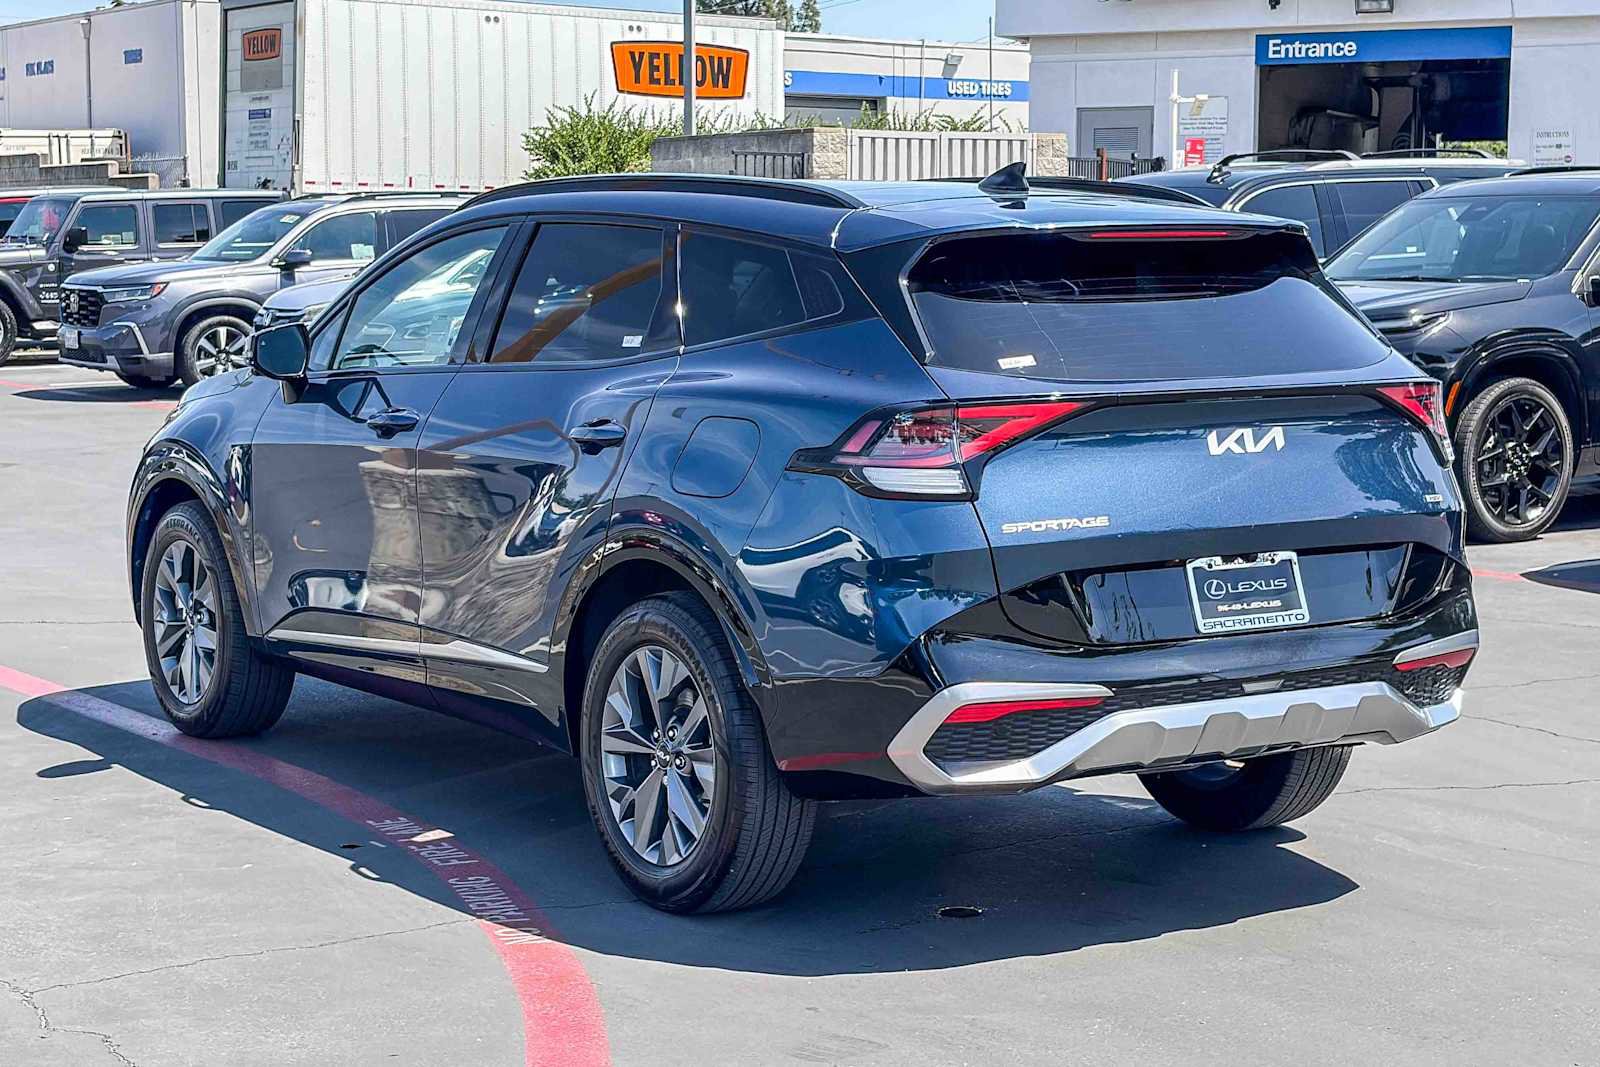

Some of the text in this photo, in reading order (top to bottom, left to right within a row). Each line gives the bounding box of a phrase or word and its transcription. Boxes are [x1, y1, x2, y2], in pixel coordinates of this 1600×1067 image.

[248, 33, 276, 55] YELLOW
[1267, 39, 1357, 59] Entrance
[948, 81, 1012, 98] USED TIRES
[1206, 426, 1286, 456] KIA
[1001, 515, 1110, 534] SPORTAGE
[1227, 577, 1288, 594] LEXUS
[1203, 612, 1305, 631] SACRAMENTO
[408, 841, 479, 866] FIRE
[448, 876, 530, 923] PARKING
